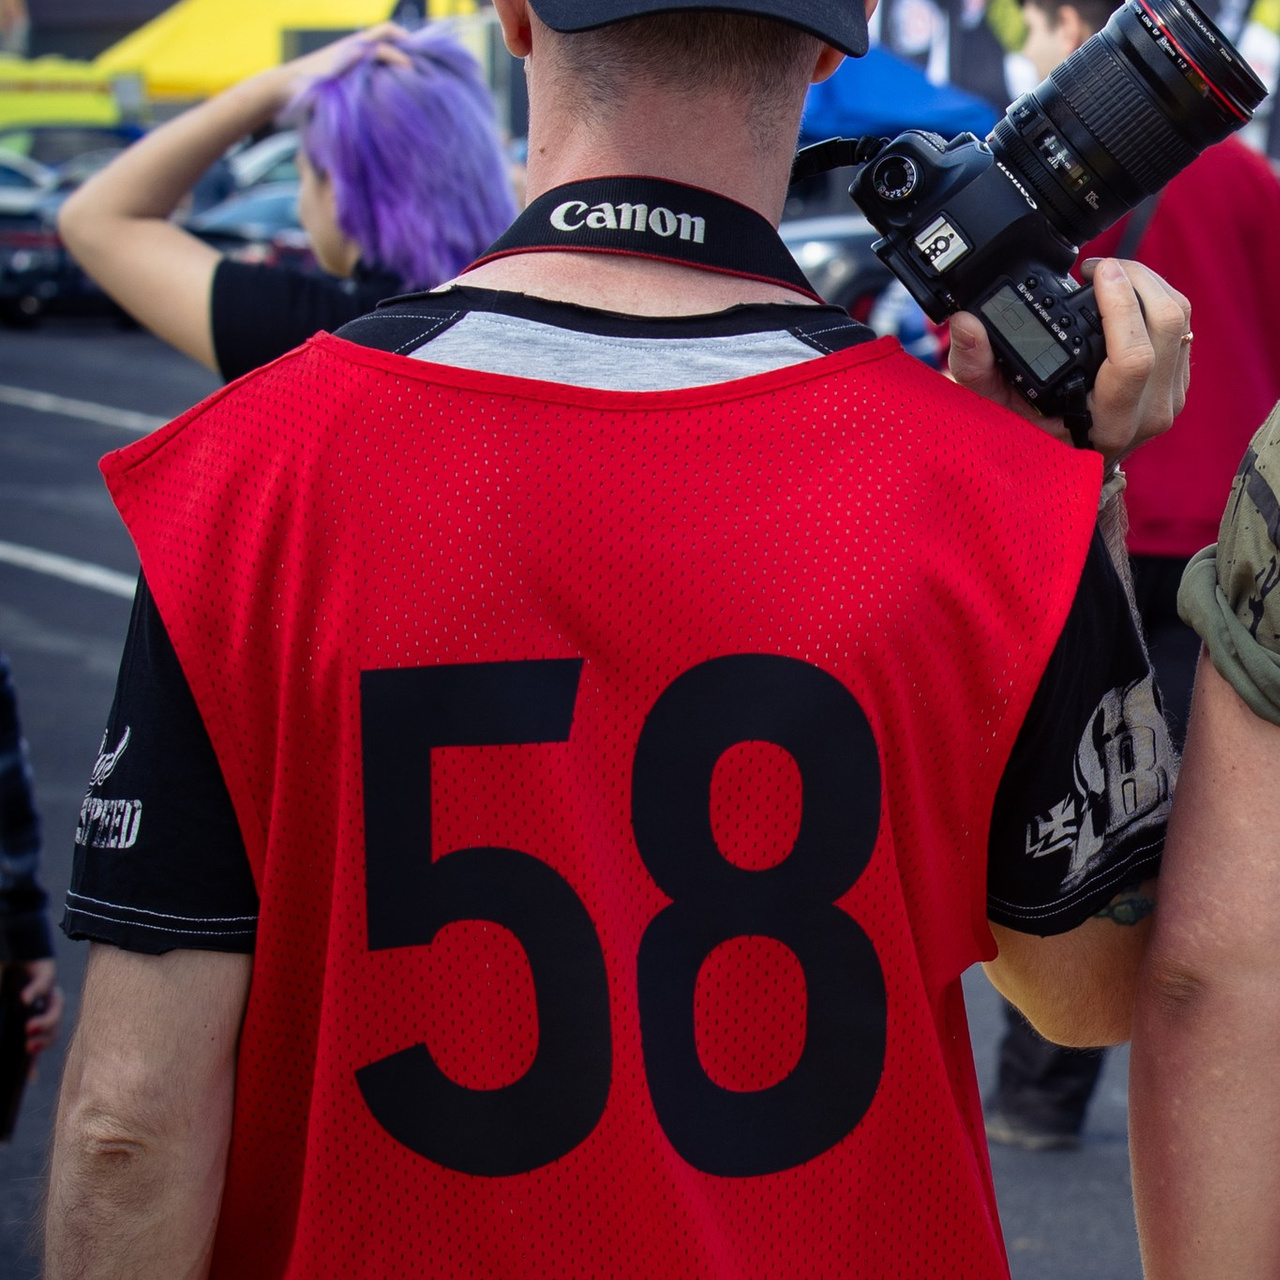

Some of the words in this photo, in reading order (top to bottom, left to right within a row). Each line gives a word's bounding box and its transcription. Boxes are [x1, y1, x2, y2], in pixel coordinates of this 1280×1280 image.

[997, 162, 1038, 210] Canon
[550, 200, 706, 244] Canon
[354, 653, 887, 1178] 58
